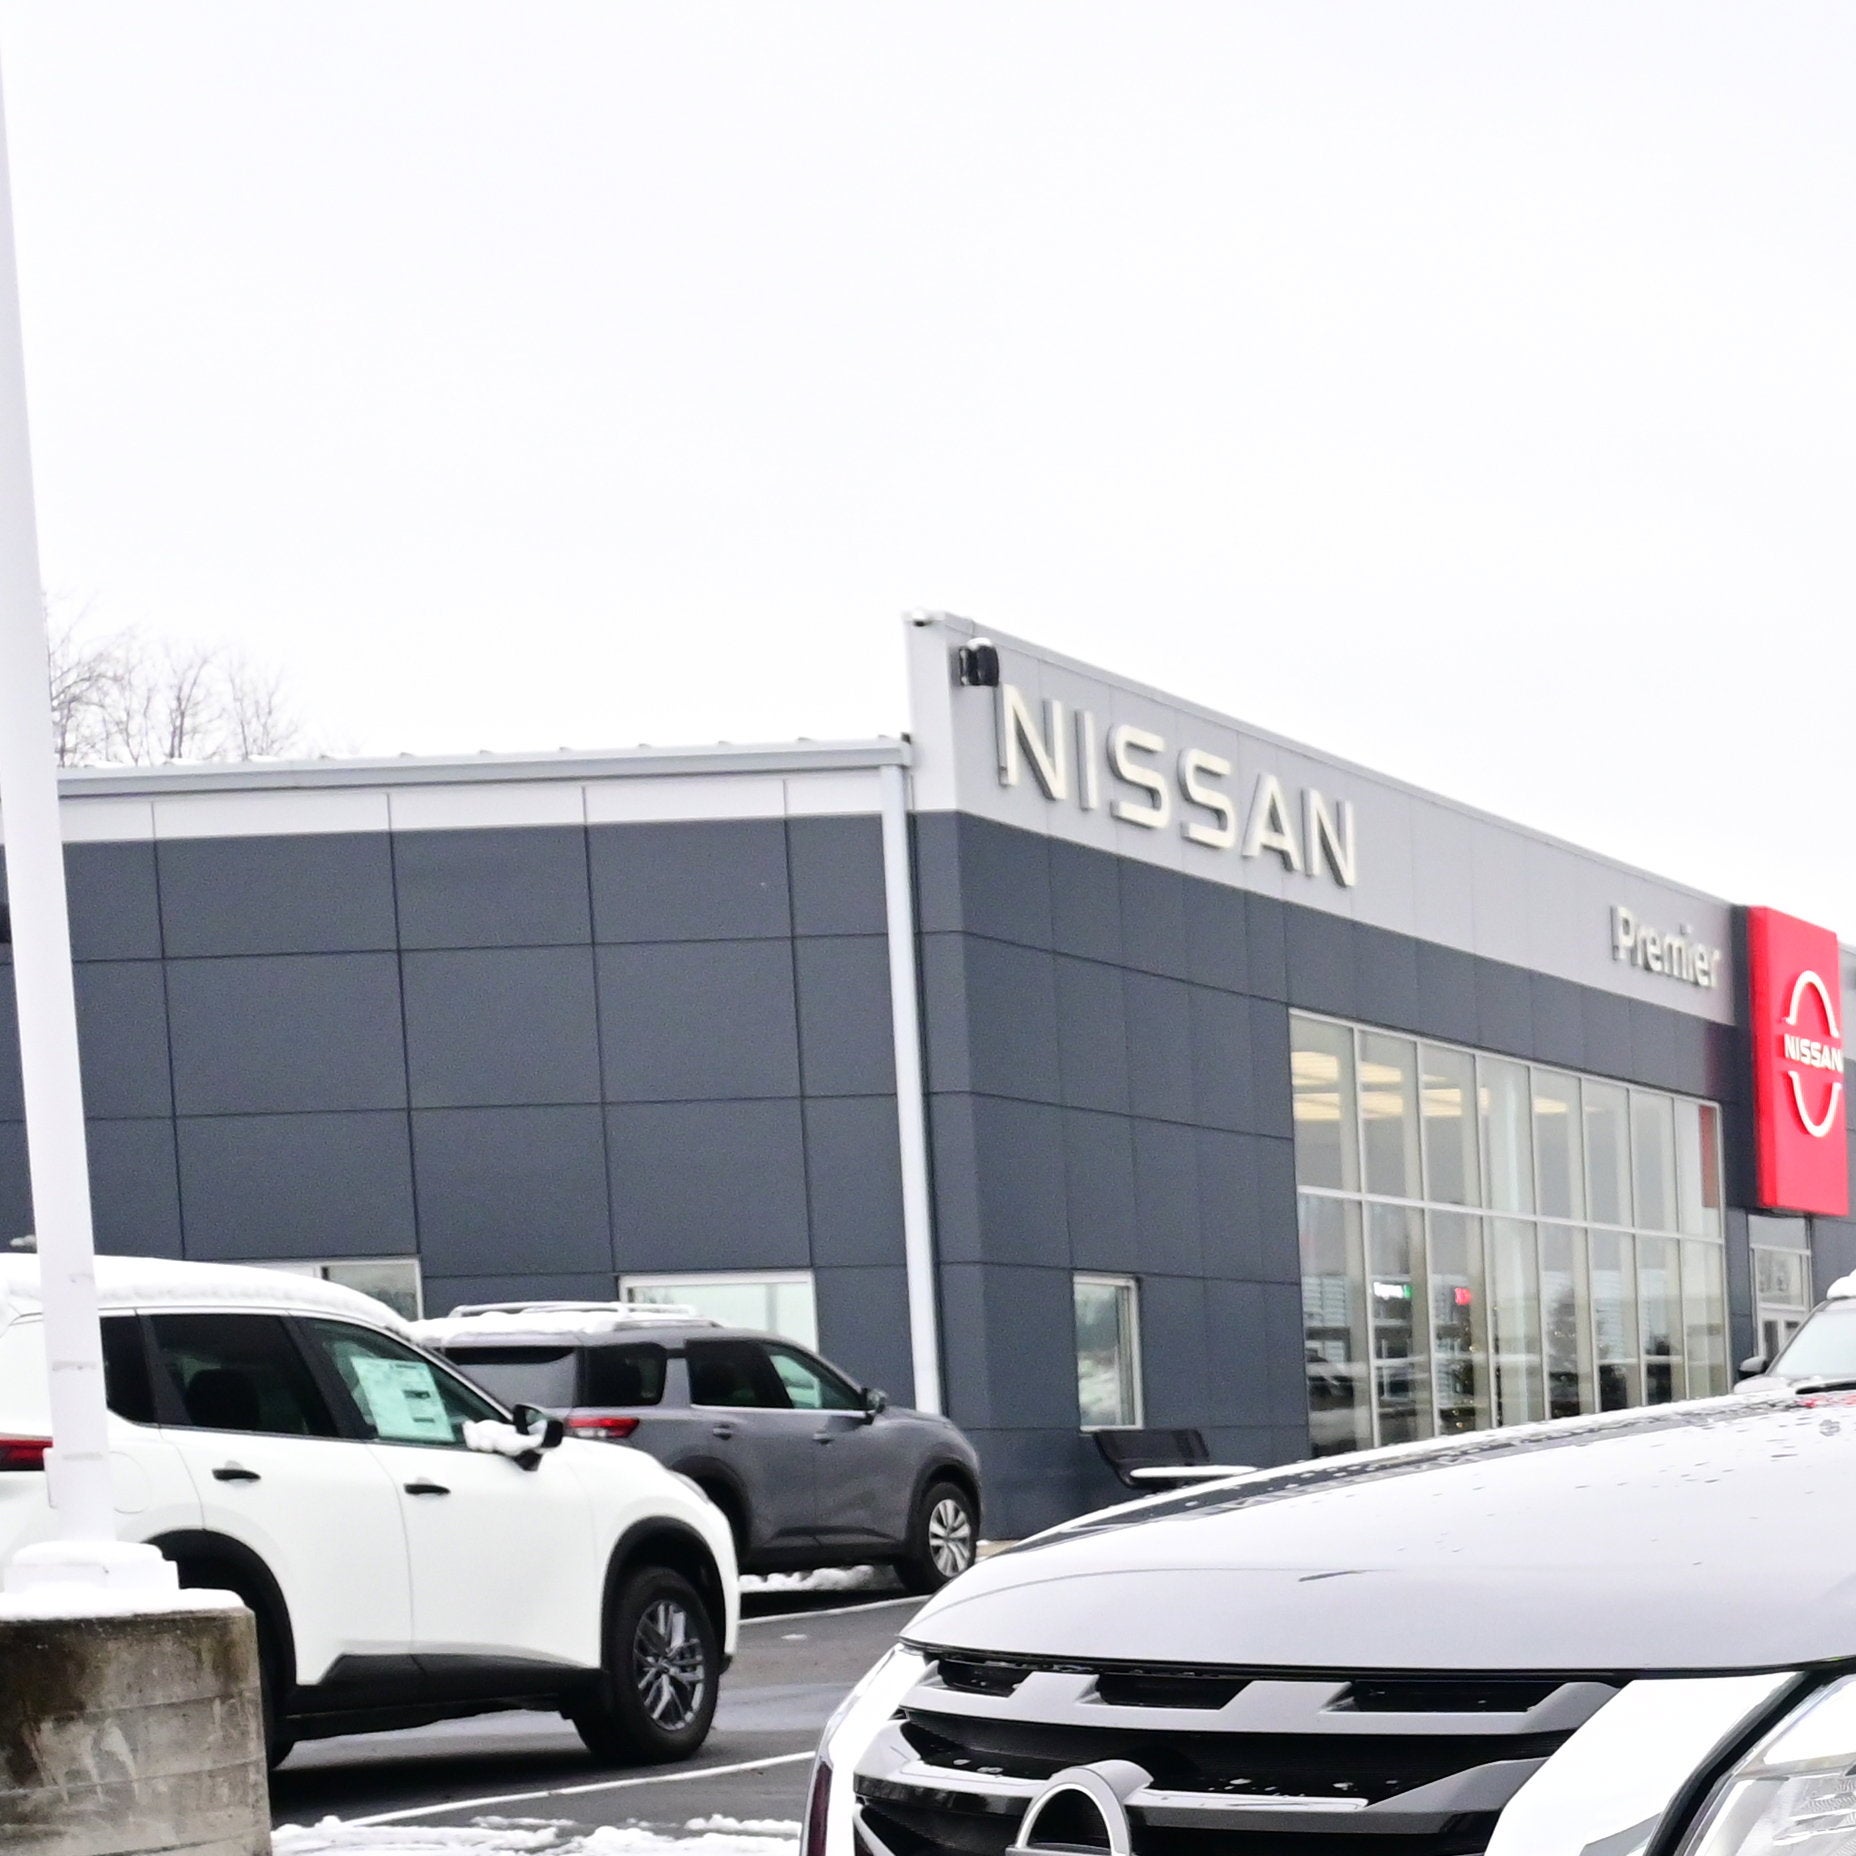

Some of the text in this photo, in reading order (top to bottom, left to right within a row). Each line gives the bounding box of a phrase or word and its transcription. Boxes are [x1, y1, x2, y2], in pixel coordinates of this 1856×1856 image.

[996, 683, 1355, 888] NISSAN
[1612, 905, 1721, 988] Premier
[1784, 1033, 1843, 1073] NISSAN
